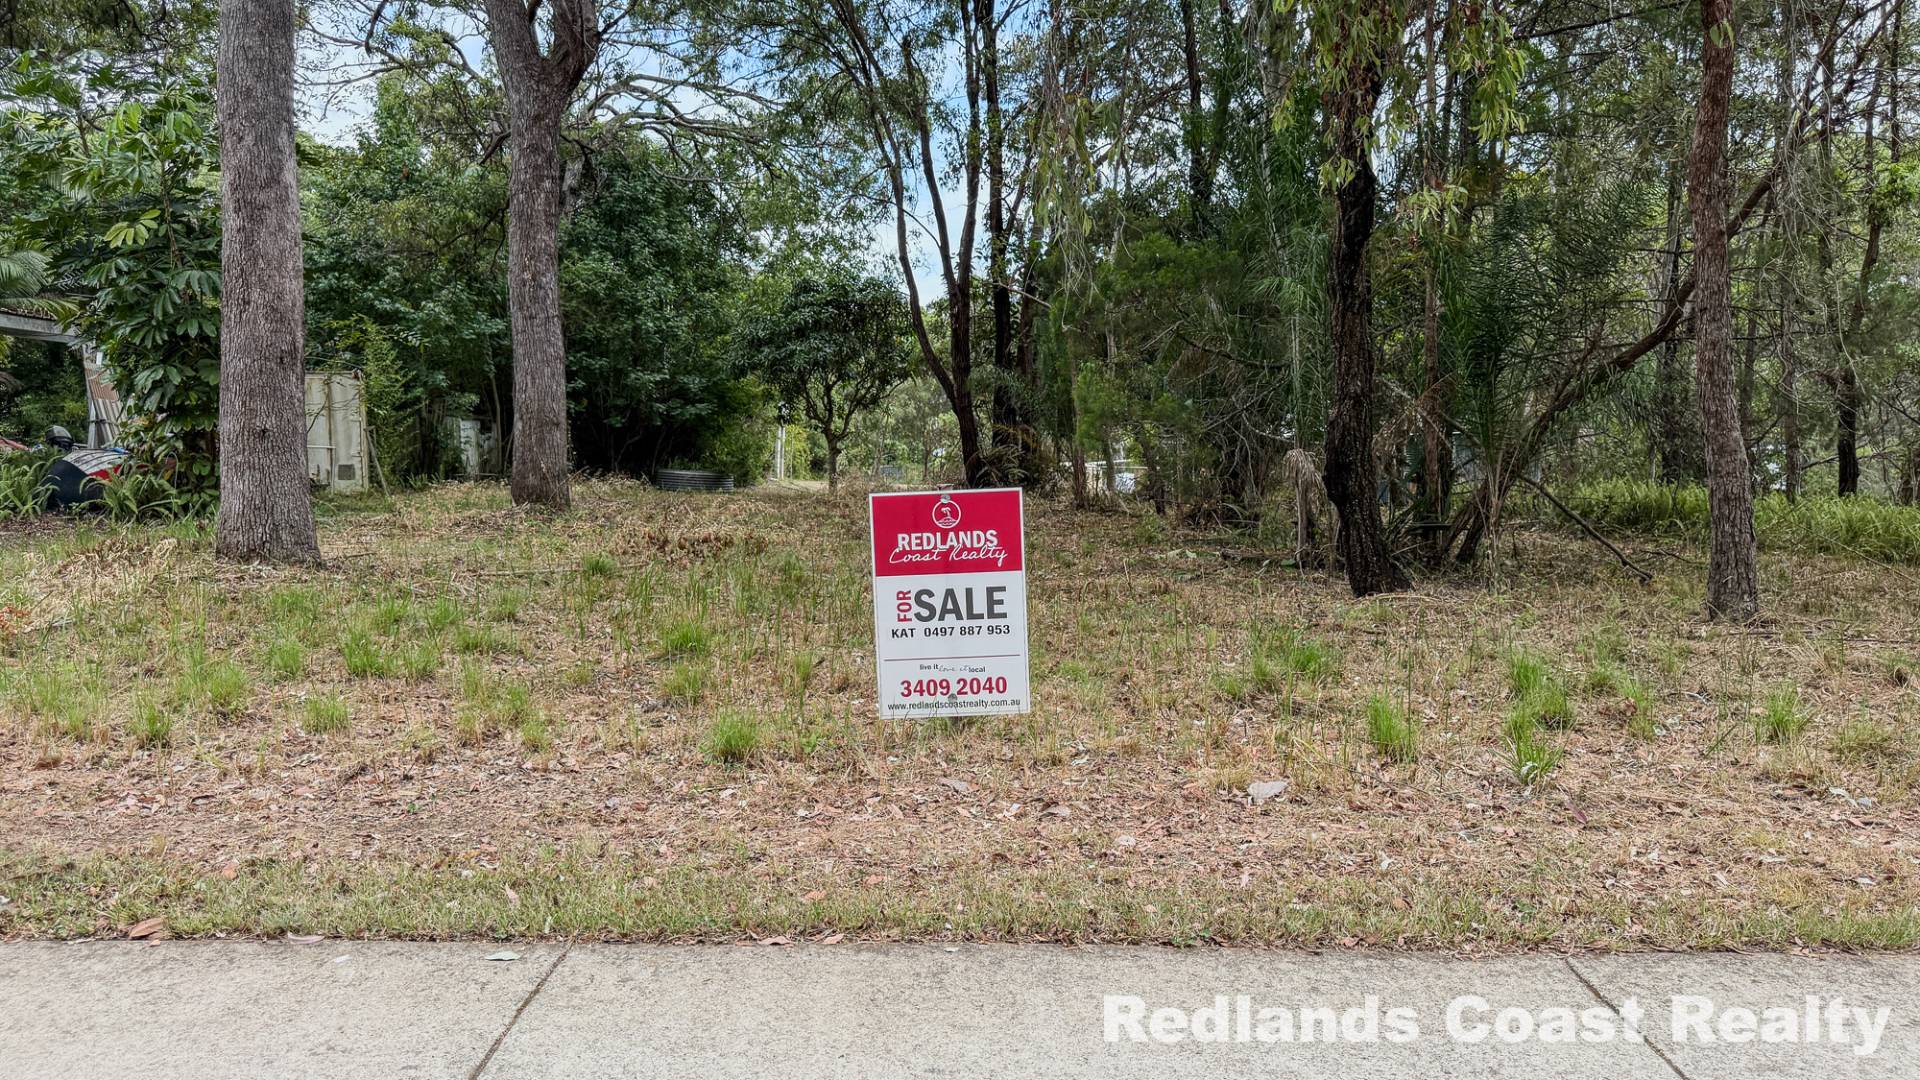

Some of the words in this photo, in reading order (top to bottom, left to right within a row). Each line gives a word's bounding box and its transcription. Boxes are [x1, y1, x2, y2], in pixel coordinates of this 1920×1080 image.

[898, 529, 998, 550] REDLANDS
[889, 547, 947, 564] Coast
[949, 544, 1008, 567] Realty
[896, 589, 912, 622] FOR
[914, 586, 1008, 622] SALE
[891, 627, 916, 639] KAT
[924, 626, 954, 637] 0497
[959, 625, 982, 636] 887
[987, 624, 1010, 635] 953
[900, 678, 950, 698] 3409
[956, 676, 1007, 696] 2040
[887, 698, 1021, 711] www.redlandscoastrealty.com.au
